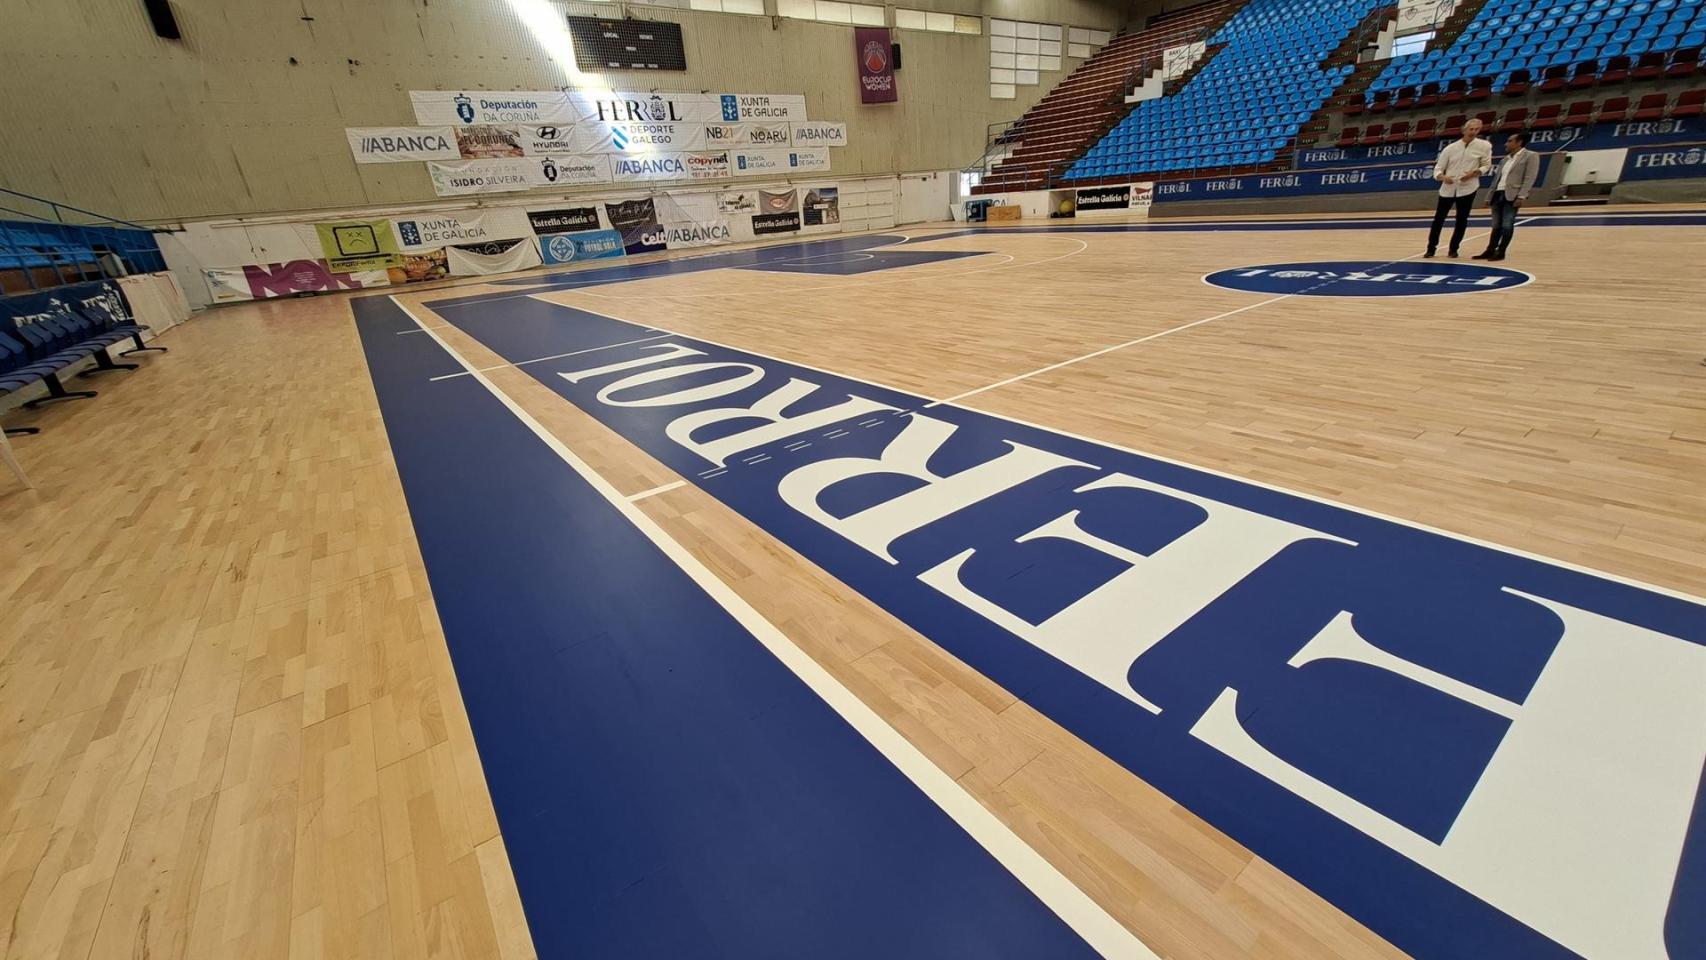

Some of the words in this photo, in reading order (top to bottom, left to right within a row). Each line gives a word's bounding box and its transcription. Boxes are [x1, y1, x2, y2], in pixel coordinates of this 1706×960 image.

[862, 75, 892, 84] EUROCUP
[865, 83, 891, 91] WOMEN
[480, 99, 538, 111] Deputación
[740, 97, 770, 107] XUNTA
[483, 112, 498, 122] DA
[500, 110, 540, 122] CORUÑA
[597, 97, 683, 122] FERROL
[741, 108, 753, 117] DE
[754, 107, 788, 117] GALICIA
[630, 125, 675, 134] DEPORTE
[706, 127, 734, 139] NB21
[1613, 118, 1687, 138] FERROL
[632, 135, 671, 144] GALEGO
[1529, 127, 1584, 144] ERROL
[1305, 149, 1348, 162] FERROL
[1367, 143, 1415, 158] FERROL
[687, 153, 729, 166] copynet
[1634, 148, 1706, 168] FERRO
[560, 164, 596, 174] Deputación
[1389, 165, 1436, 182] FERRO
[449, 177, 484, 187] ISIDRO
[486, 176, 526, 186] SILVEIRA
[1260, 175, 1302, 189] FERROL
[1321, 170, 1368, 185] FERROL
[1158, 181, 1192, 194] FERROL
[1206, 178, 1243, 191] FERROL
[1078, 195, 1100, 205] Estrella
[1100, 193, 1122, 204] Galicia
[421, 219, 461, 230] XUNTA
[532, 216, 561, 227] Estrella
[561, 213, 588, 225] Galicia
[424, 231, 440, 241] DE
[441, 228, 487, 240] GALICIA
[557, 342, 1706, 960] FERROL
